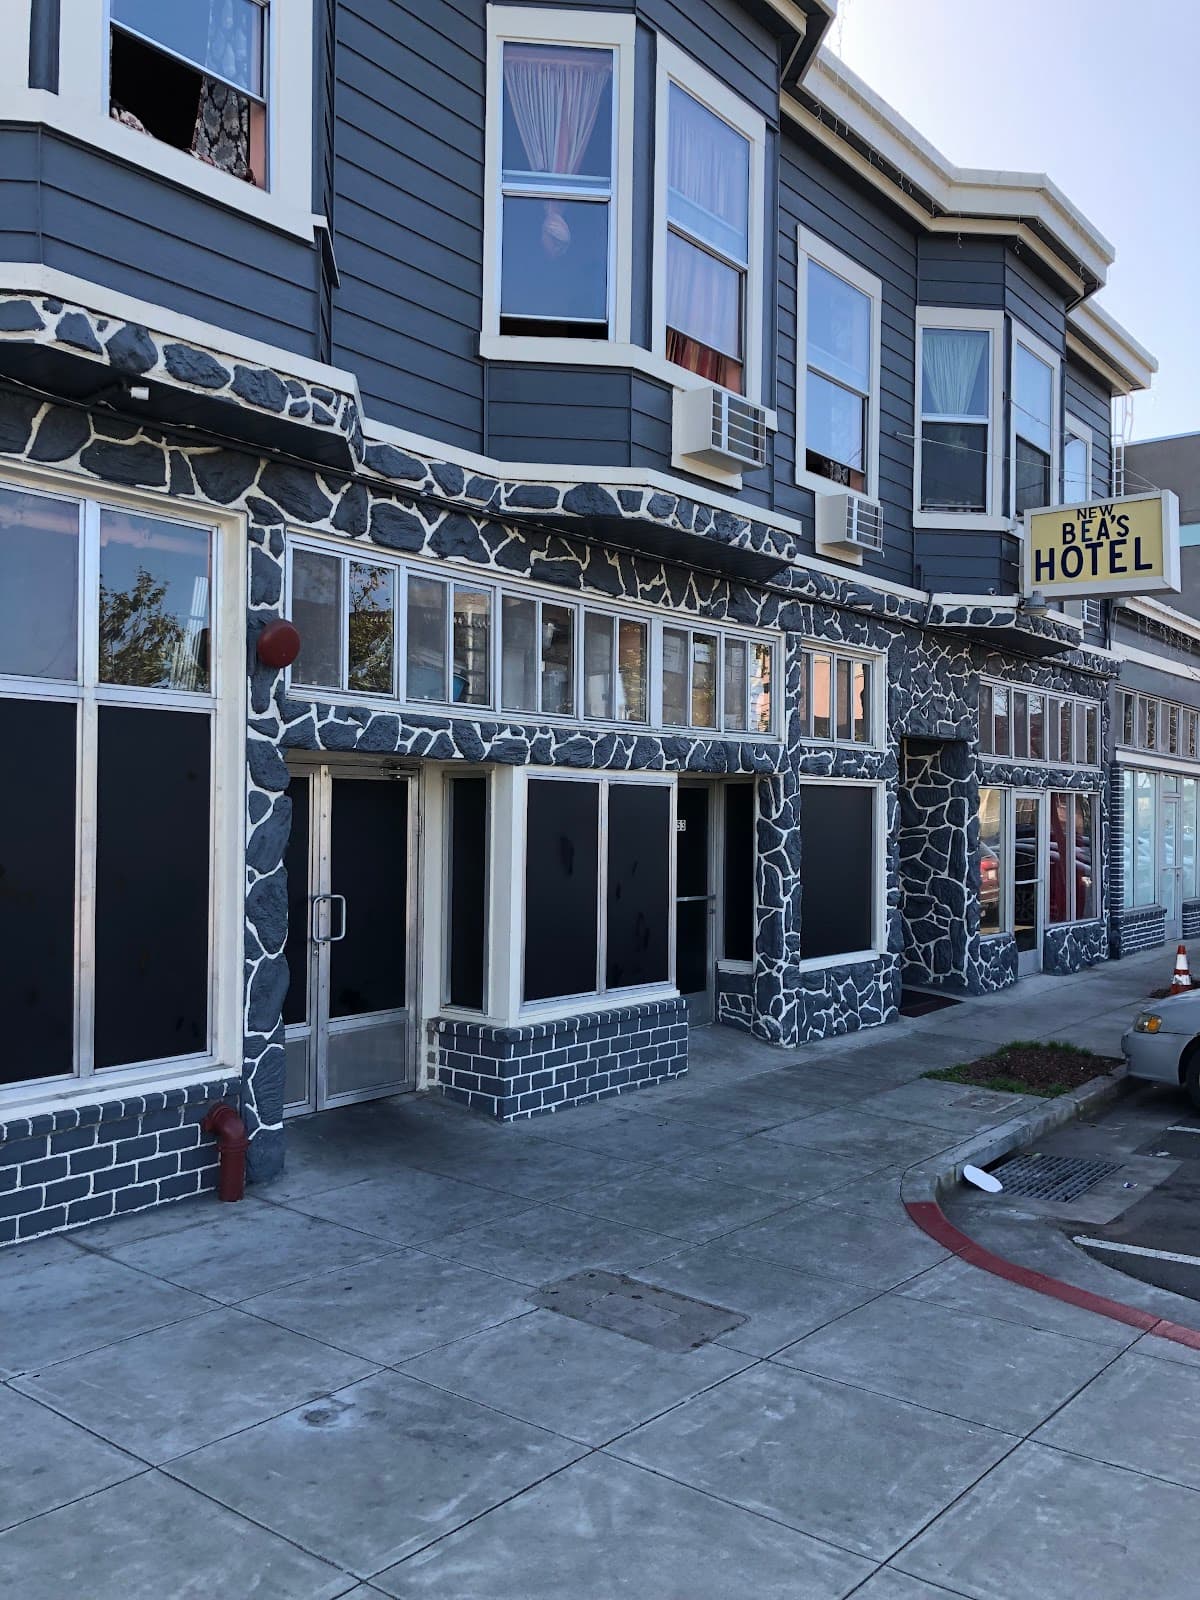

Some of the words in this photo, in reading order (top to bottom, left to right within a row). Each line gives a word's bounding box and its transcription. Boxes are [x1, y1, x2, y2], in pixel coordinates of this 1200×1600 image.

[1077, 504, 1114, 520] NEW
[1062, 515, 1130, 545] BEA'S
[1035, 537, 1153, 582] HOTEL
